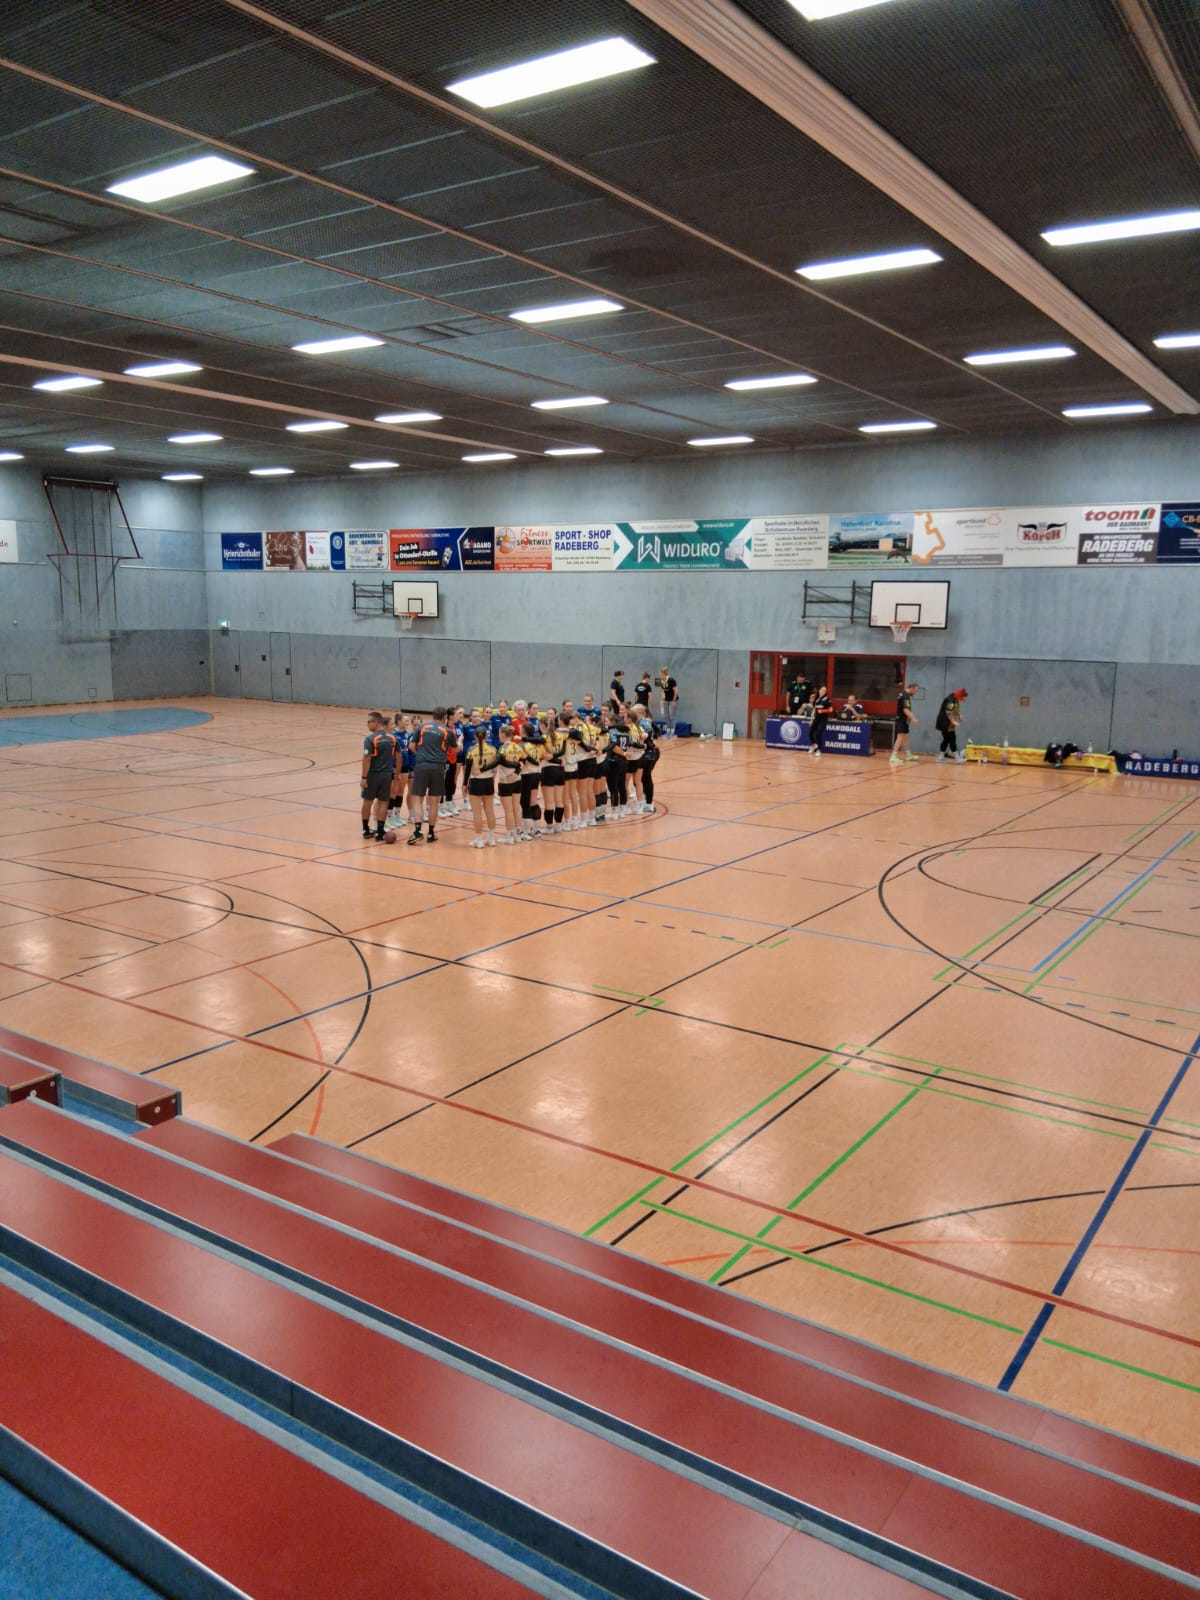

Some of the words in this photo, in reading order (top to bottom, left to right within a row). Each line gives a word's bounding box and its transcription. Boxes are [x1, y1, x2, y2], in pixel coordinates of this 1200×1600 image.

[1084, 509, 1141, 522] toom
[554, 531, 582, 541] SPORT
[588, 529, 612, 540] SHOP
[554, 541, 599, 551] RADEBERG
[663, 542, 721, 558] WIDURO
[1082, 539, 1155, 553] RADEBERG
[826, 724, 862, 733] HANDBALL
[825, 741, 861, 750] RADEBERG
[1125, 760, 1199, 775] RADEBERG
